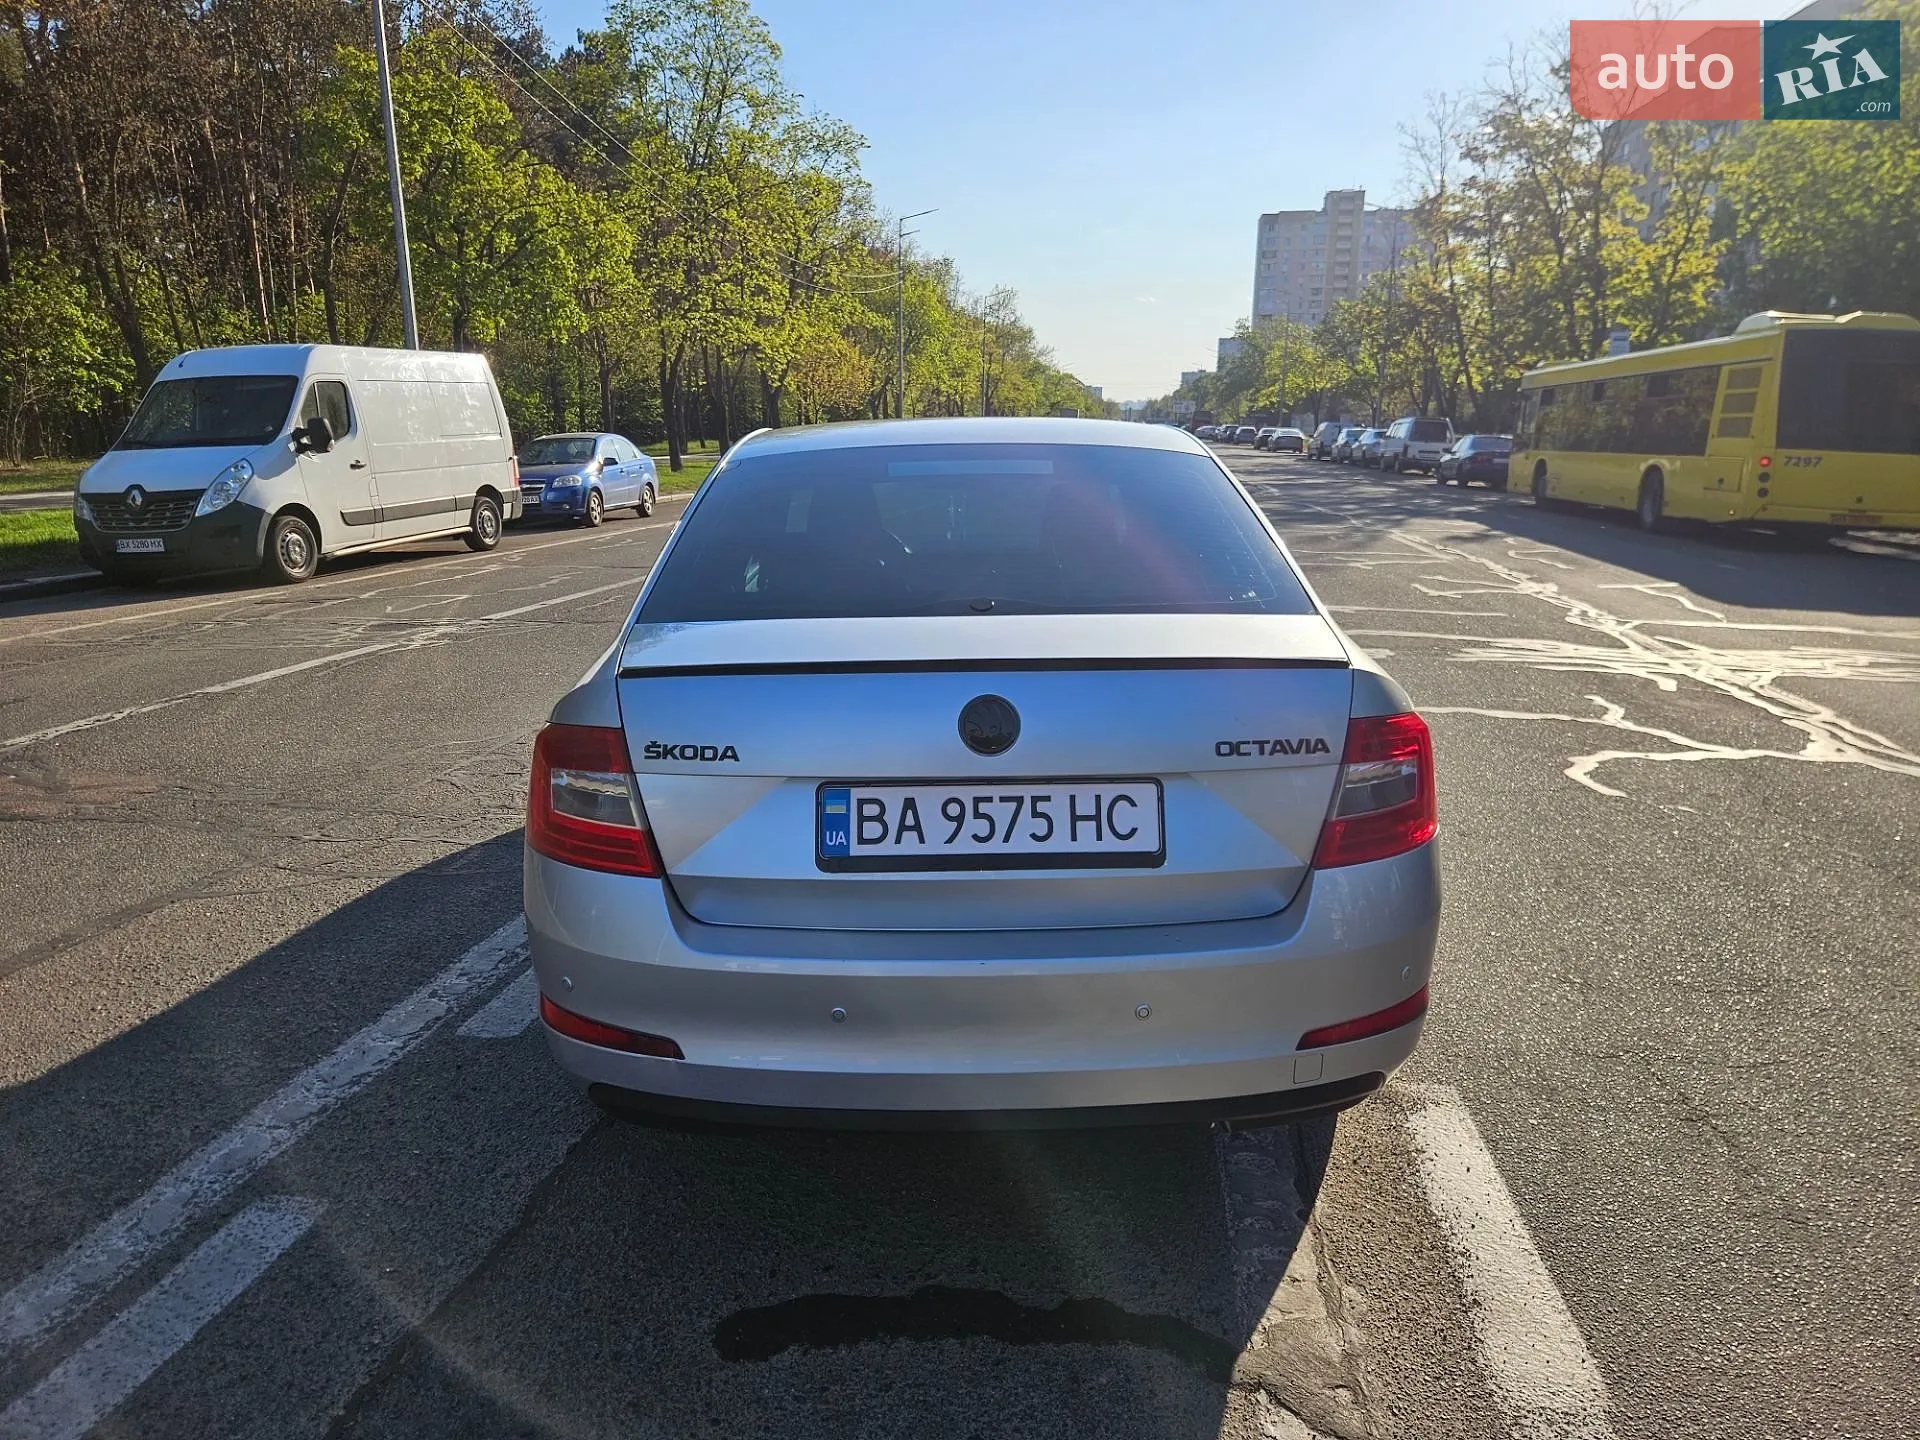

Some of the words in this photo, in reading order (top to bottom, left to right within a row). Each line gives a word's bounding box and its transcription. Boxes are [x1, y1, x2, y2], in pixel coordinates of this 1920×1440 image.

[1784, 455, 1823, 468] 7297
[643, 740, 741, 762] ŠKODA
[1215, 737, 1331, 757] OCTAVIA
[857, 797, 924, 846] BA
[940, 795, 1054, 846] 9575
[1069, 794, 1139, 843] HC
[825, 829, 848, 847] UA
